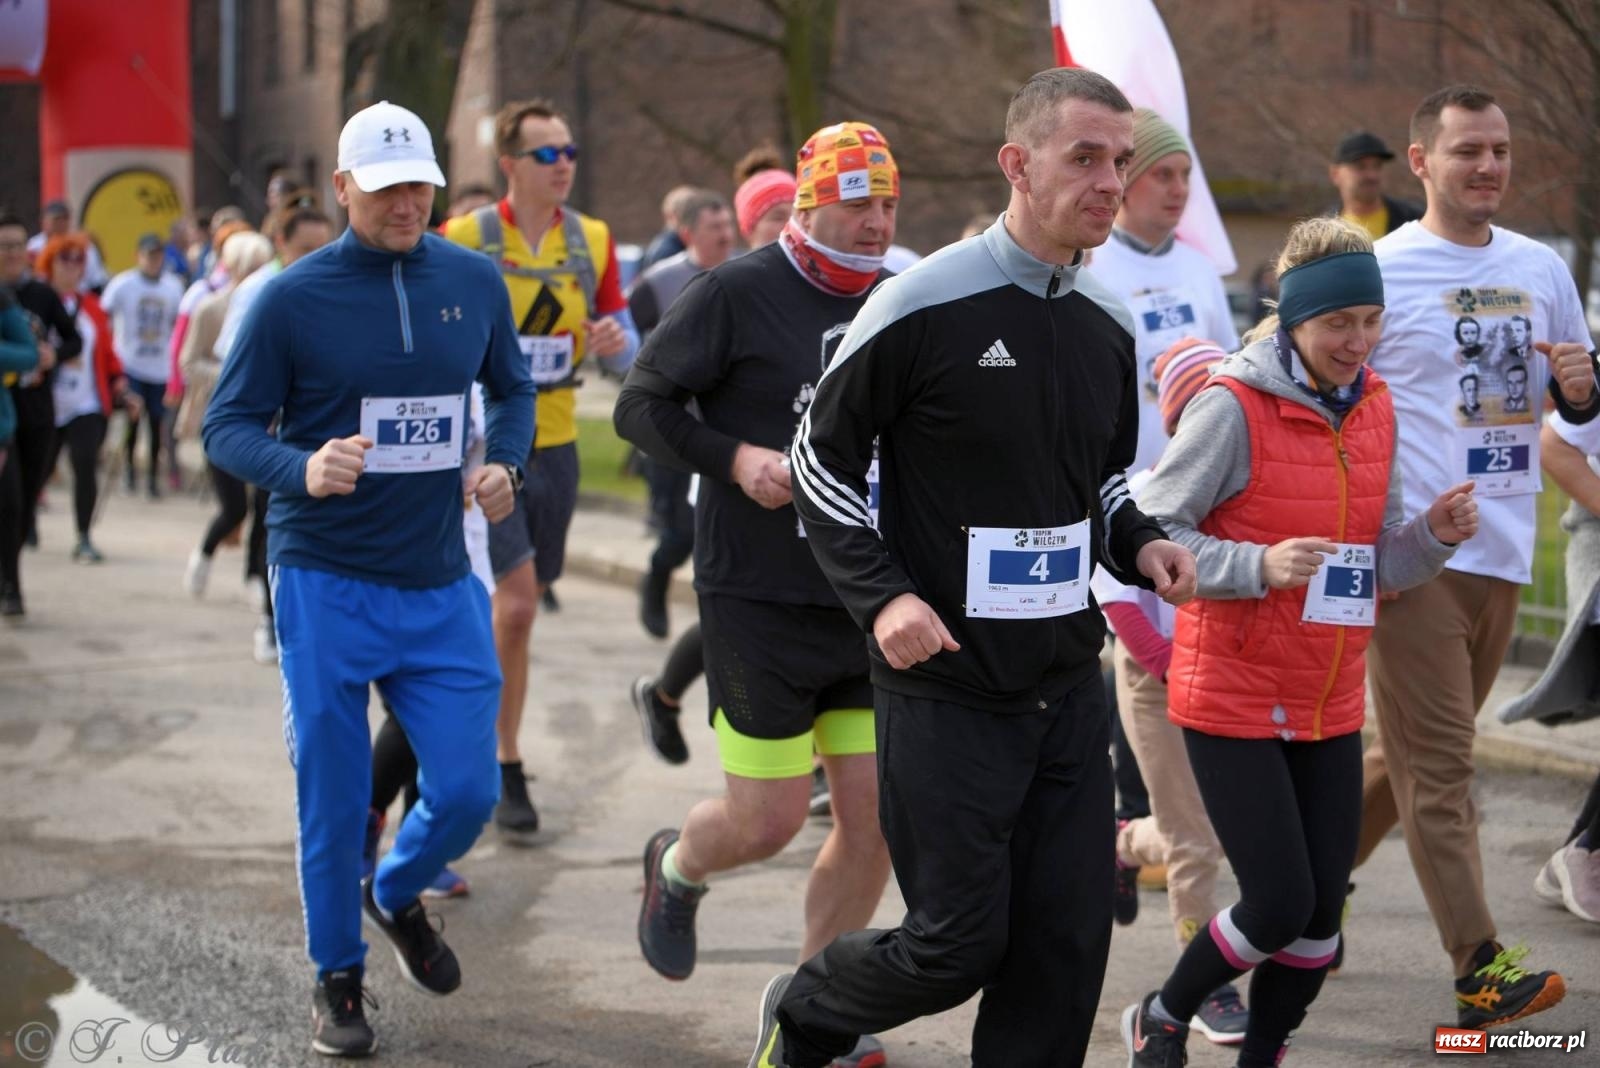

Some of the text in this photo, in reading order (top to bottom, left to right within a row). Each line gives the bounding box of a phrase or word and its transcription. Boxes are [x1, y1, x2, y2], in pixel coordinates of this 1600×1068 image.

[978, 357, 1017, 367] adidas
[395, 419, 440, 444] 126
[1486, 447, 1512, 471] 25
[1033, 535, 1067, 547] WILCZYM
[1029, 552, 1050, 582] 4
[1349, 569, 1363, 596] 3
